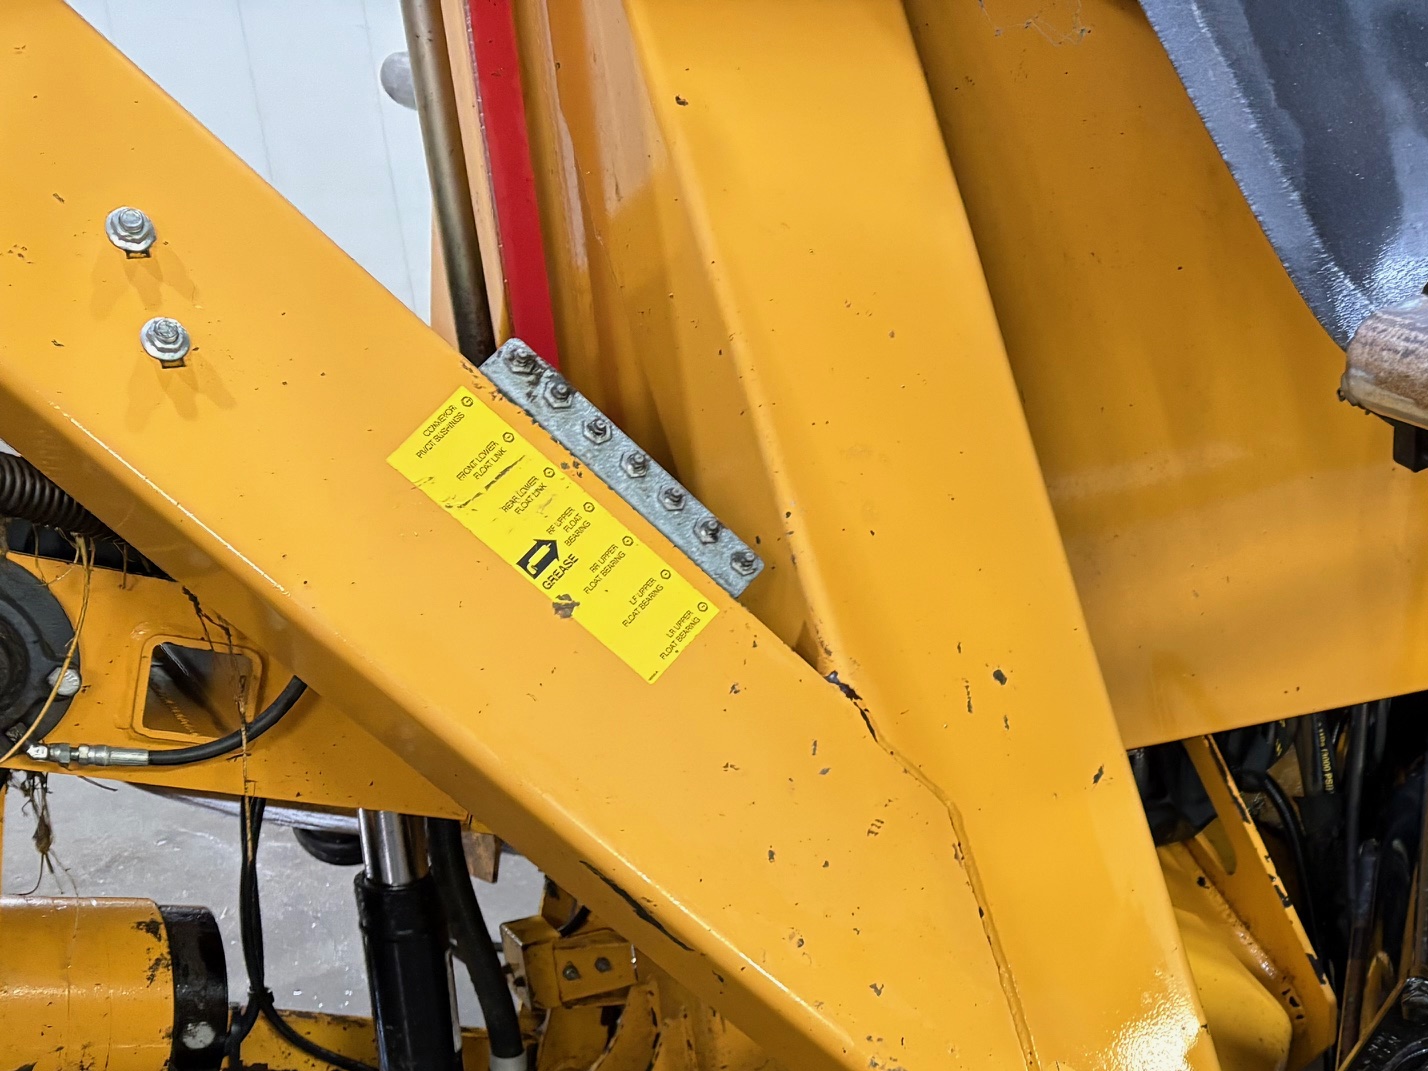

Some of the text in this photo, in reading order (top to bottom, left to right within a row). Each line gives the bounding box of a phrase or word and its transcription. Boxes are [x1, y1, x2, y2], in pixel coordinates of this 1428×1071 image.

[416, 412, 465, 459] PIVOT BUSHINGS
[423, 405, 458, 437] CONVEYOR
[456, 441, 500, 481] FRONT LOWER
[473, 447, 507, 480] FLOAT LINK
[501, 476, 540, 513] REAR LOWER
[514, 483, 548, 515] FLOAT LINK
[546, 507, 576, 535] RF UPPER
[563, 513, 583, 533] FLOAT
[564, 521, 591, 547] BEARING
[542, 554, 579, 591] GREASE
[584, 551, 626, 595] FLOAT BEARING
[590, 544, 619, 574] RR UPPER
[622, 585, 664, 628] FLOAT BEARING
[629, 578, 657, 606] LF UPPER
[660, 617, 701, 660] FLOAT BEARING
[666, 610, 694, 639] LR UPPER
